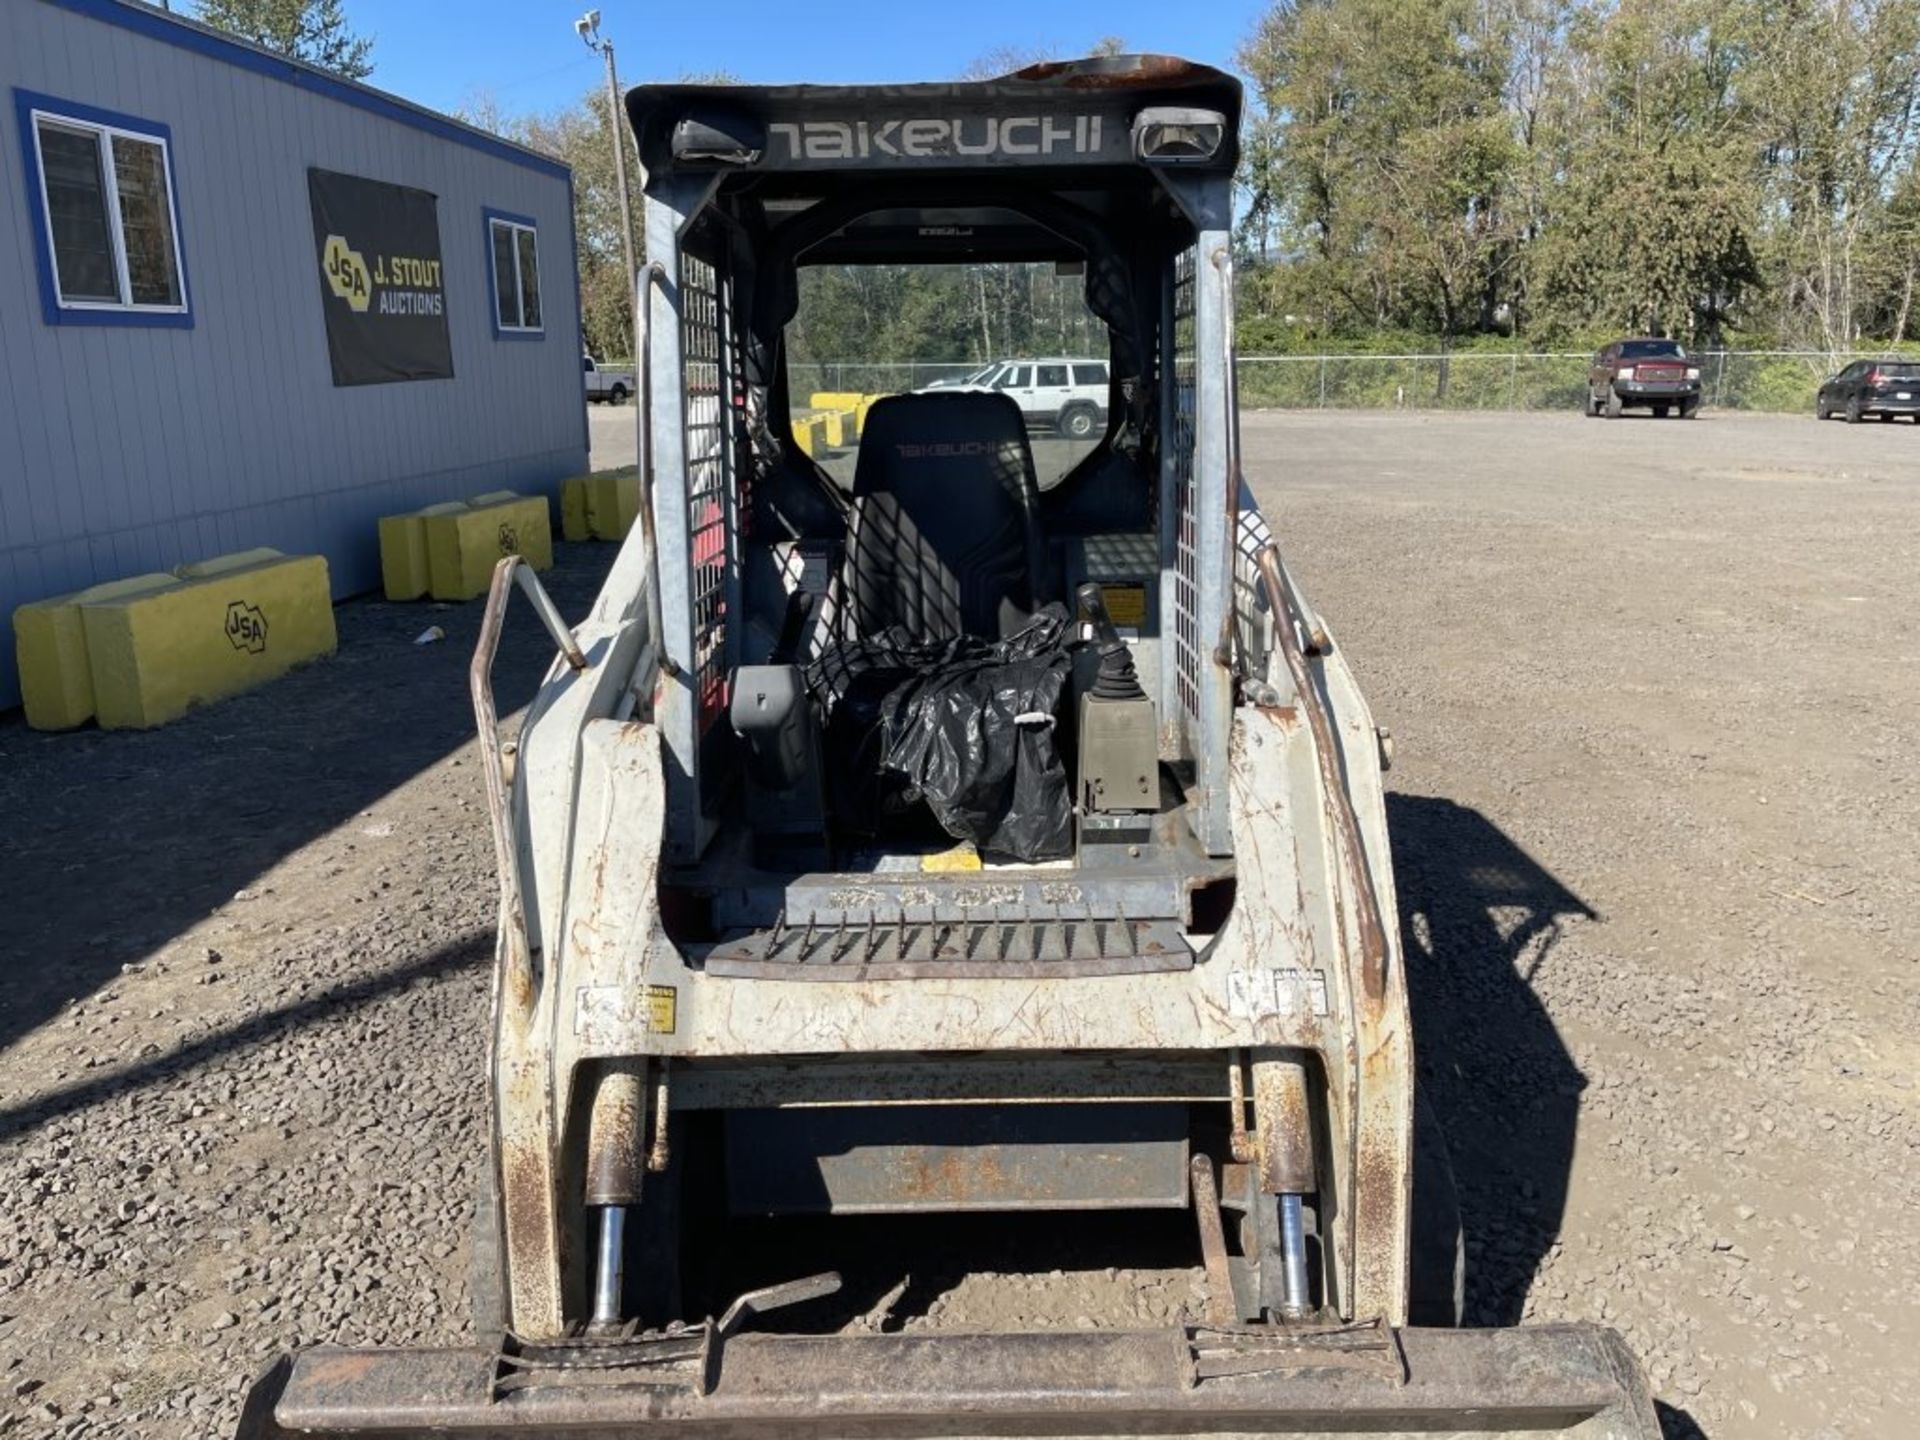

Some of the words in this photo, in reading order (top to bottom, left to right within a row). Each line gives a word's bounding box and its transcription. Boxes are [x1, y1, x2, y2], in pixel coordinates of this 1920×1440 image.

[329, 245, 366, 297] JSA
[374, 254, 389, 285] J.
[391, 256, 440, 288] STOUT
[379, 290, 442, 315] AUCTIONS
[230, 610, 263, 642] JSA
